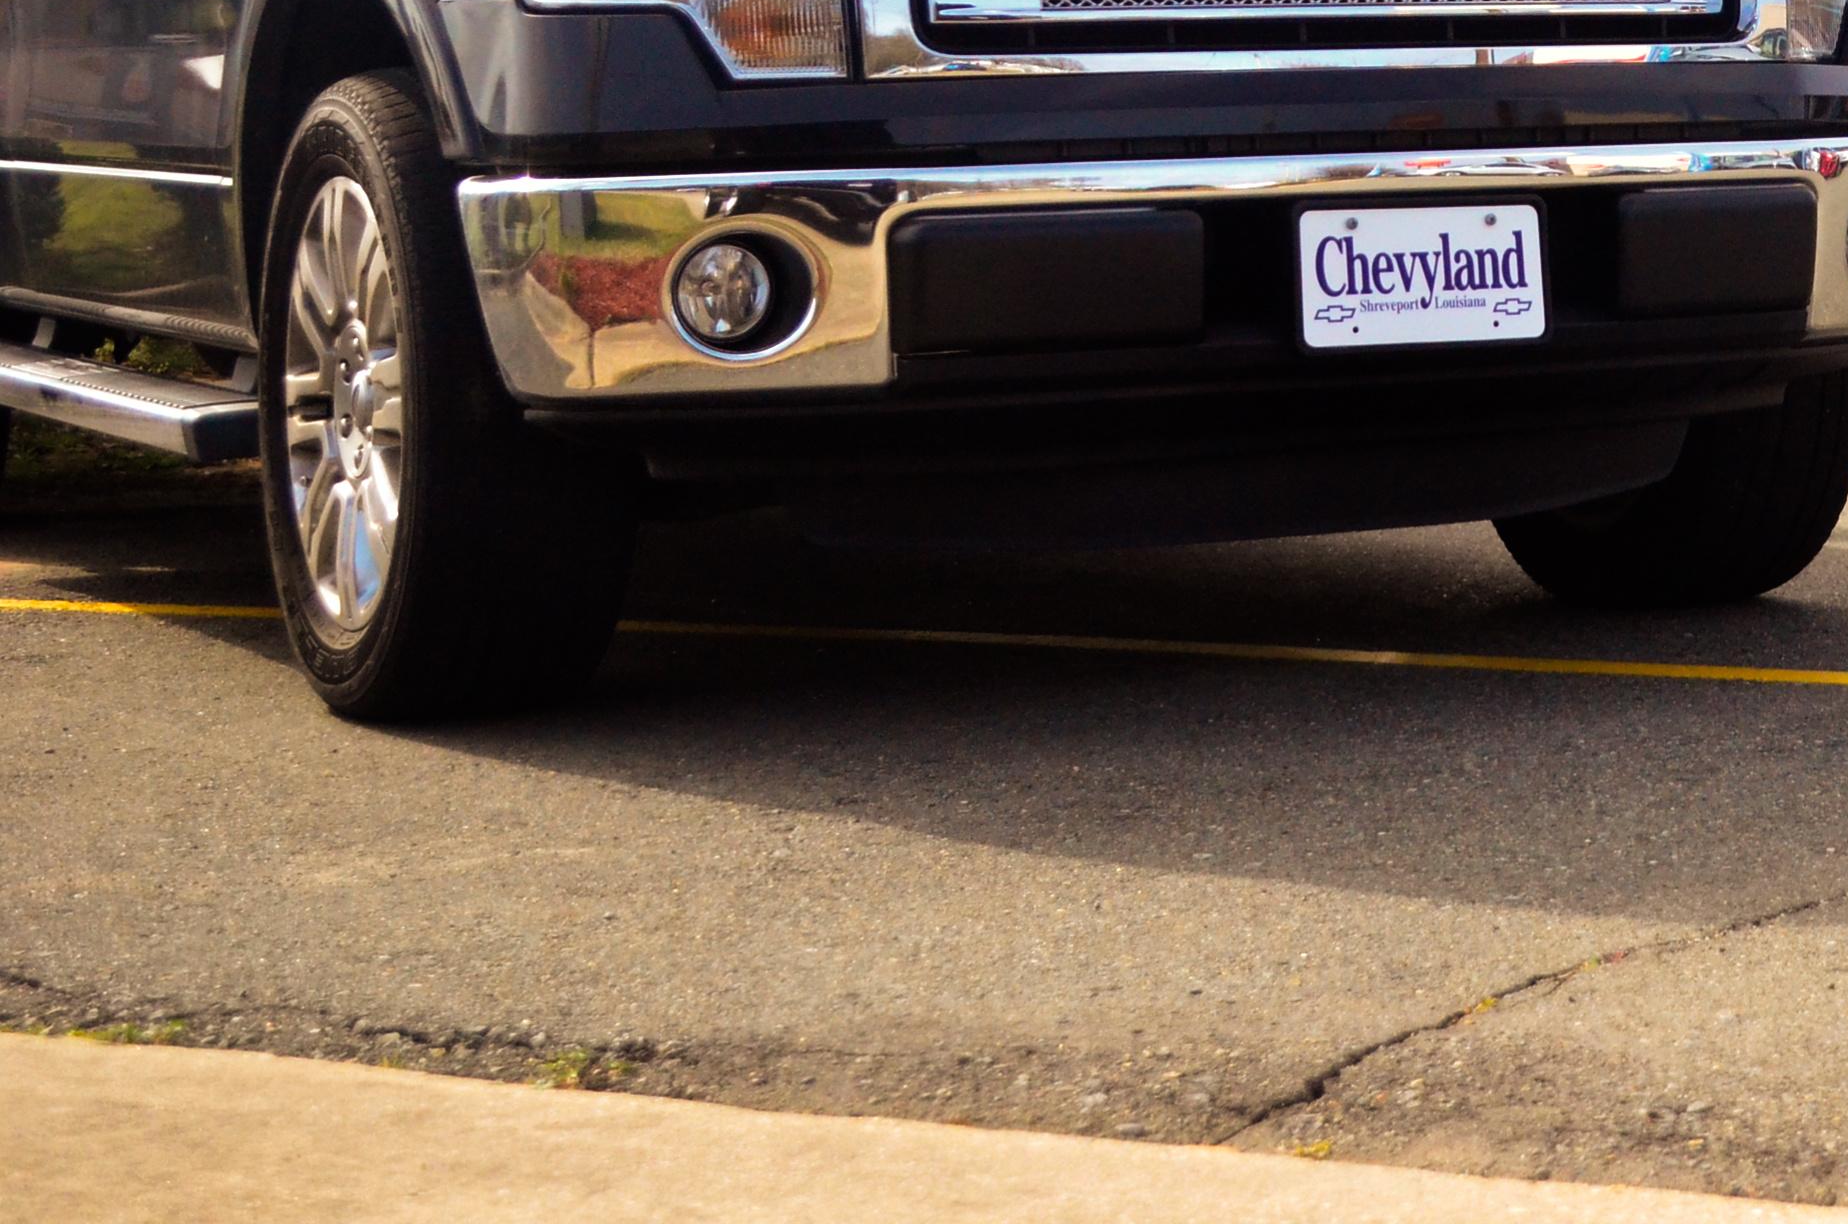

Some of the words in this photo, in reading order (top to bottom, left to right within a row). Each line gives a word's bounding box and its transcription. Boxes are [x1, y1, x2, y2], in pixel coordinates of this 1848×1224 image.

[1314, 229, 1529, 310] Chevyland
[1359, 296, 1420, 315] Shreveport
[1434, 295, 1487, 310] Louisiana
